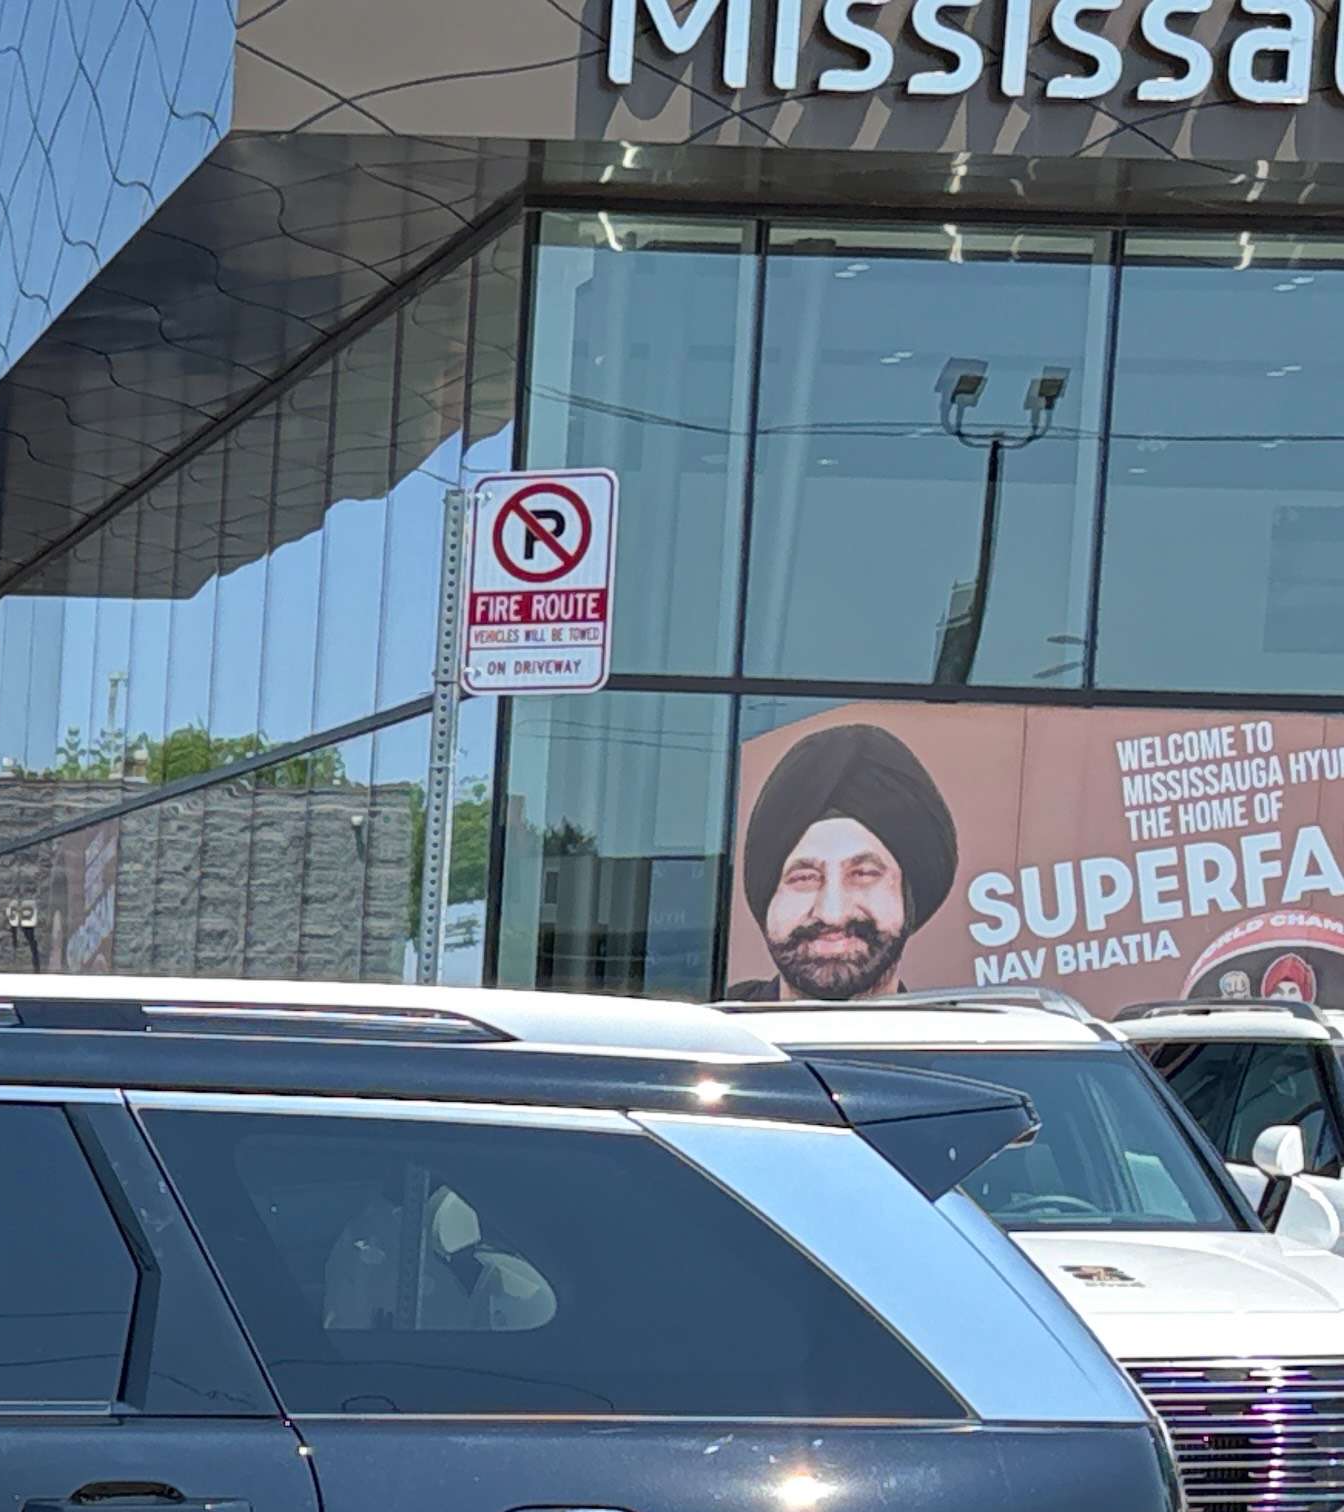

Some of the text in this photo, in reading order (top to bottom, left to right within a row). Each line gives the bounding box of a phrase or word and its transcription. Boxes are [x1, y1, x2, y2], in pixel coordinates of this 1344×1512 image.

[606, 0, 1344, 104] Mississa
[475, 592, 600, 623] FIRE ROUTE
[474, 627, 600, 644] VEHICLES WILL BE TOWED
[487, 659, 582, 676] ON DRIVEWAY
[1116, 720, 1274, 771] WELCOME TO
[1122, 747, 1344, 807] MISSISSAUGA HYU
[1125, 790, 1284, 841] THE HOME OF
[967, 825, 1344, 948] SUPERFA
[973, 929, 1181, 987] NAV BHATIA
